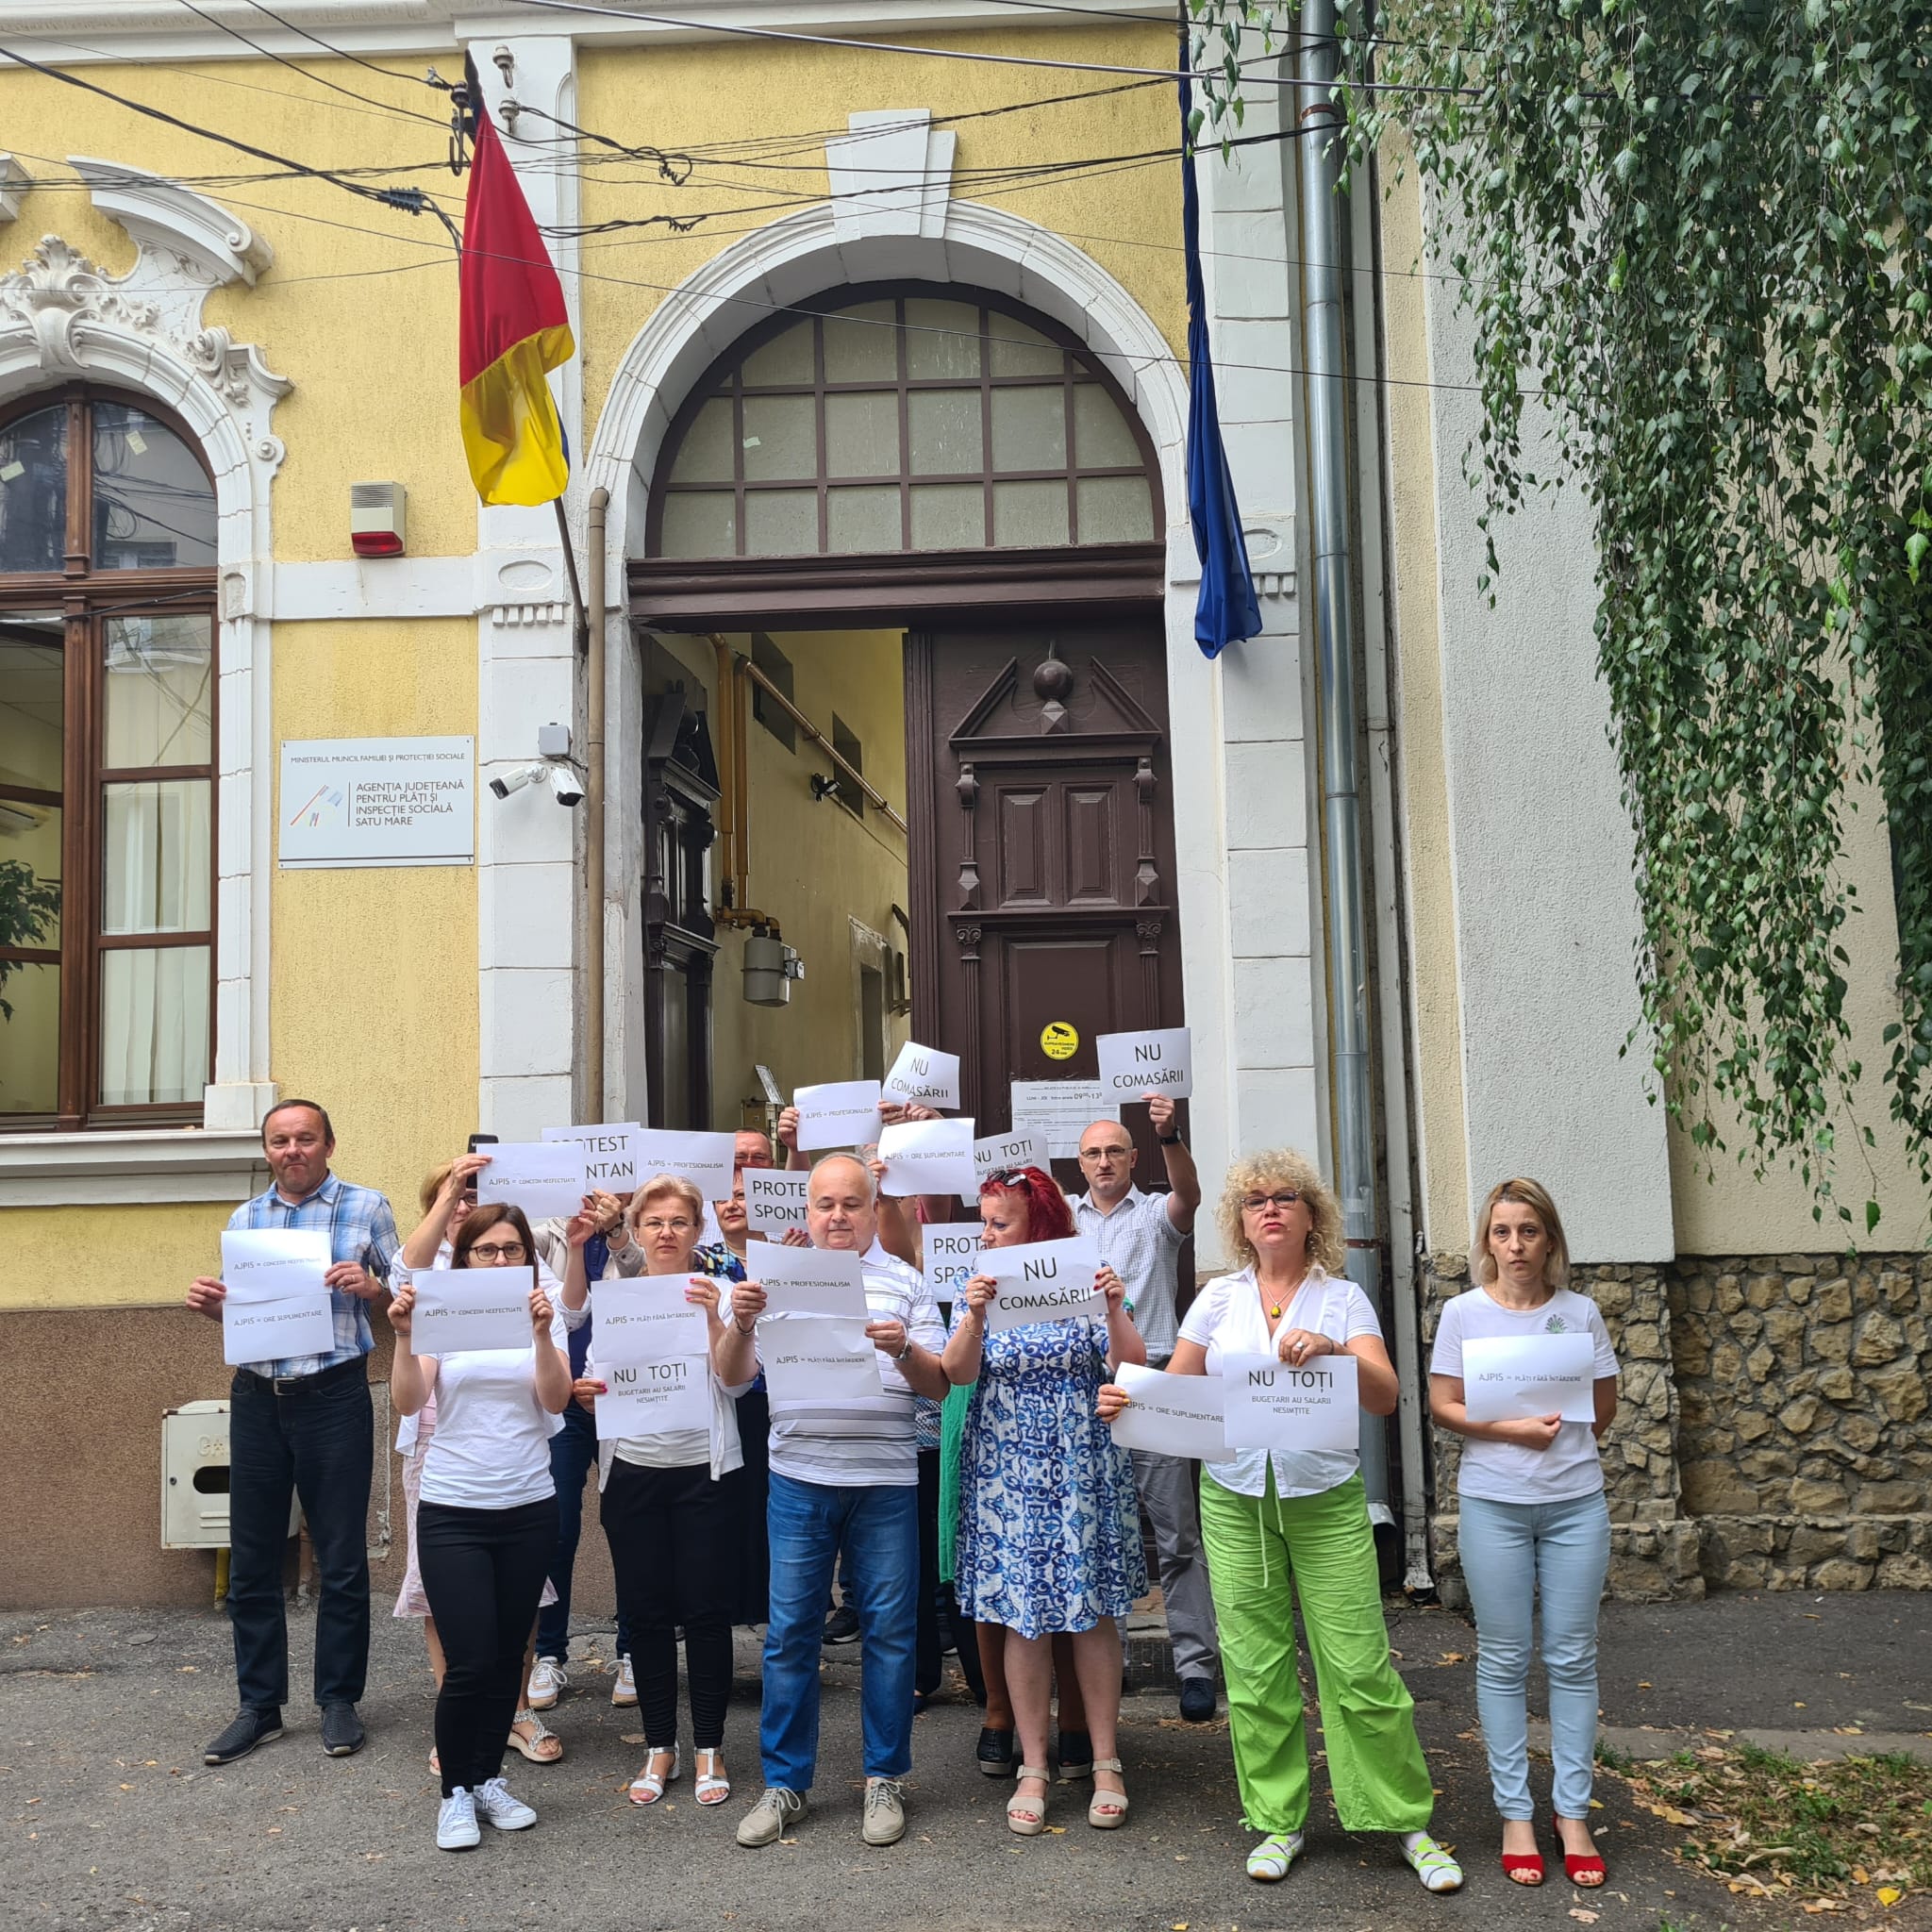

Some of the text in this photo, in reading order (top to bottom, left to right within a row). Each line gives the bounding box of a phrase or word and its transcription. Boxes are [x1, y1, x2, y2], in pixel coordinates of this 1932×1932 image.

[356, 779, 464, 793] AGENȚIA JUDEȚEANĂ
[356, 791, 438, 804] PENTRU PLĂȚI ȘI
[356, 802, 453, 816] INSPECȚIE SOCIALĂ
[355, 816, 413, 826] SATU MARE
[1135, 1043, 1161, 1062] NU
[910, 1057, 929, 1075] NU
[1113, 1068, 1184, 1089] COMASĂRII
[891, 1077, 948, 1098] COMASĂRII
[999, 1139, 1032, 1157] TOȚI
[647, 1159, 666, 1168] AJPIS
[885, 1152, 903, 1160] AJPIS
[586, 1161, 633, 1179] NTAN
[752, 1180, 807, 1196] PROTE
[755, 1204, 807, 1220] SPONT
[934, 1237, 981, 1254] PROT
[234, 1260, 255, 1270] AJPIS
[1024, 1257, 1057, 1281] NU
[999, 1287, 1091, 1310] COMASĂRII
[425, 1307, 448, 1317] AJPIS
[234, 1317, 255, 1326] AJPIS
[606, 1316, 627, 1324] AJPIS
[776, 1356, 798, 1364] AJPIS
[614, 1362, 687, 1383] NU TOȚI
[1478, 1373, 1504, 1382] AJPIS
[1248, 1370, 1332, 1393] NU TOȚI
[618, 1388, 650, 1396] BUGETARII
[663, 1384, 686, 1392] SALARII
[1252, 1395, 1290, 1404] BUGETARII
[1124, 1401, 1145, 1410] JPIS
[1156, 1407, 1170, 1415] ORE
[1172, 1409, 1224, 1423] SUPLIMENTARE
[1273, 1407, 1311, 1416] NESIMȚITE
[197, 1434, 229, 1457] GA
